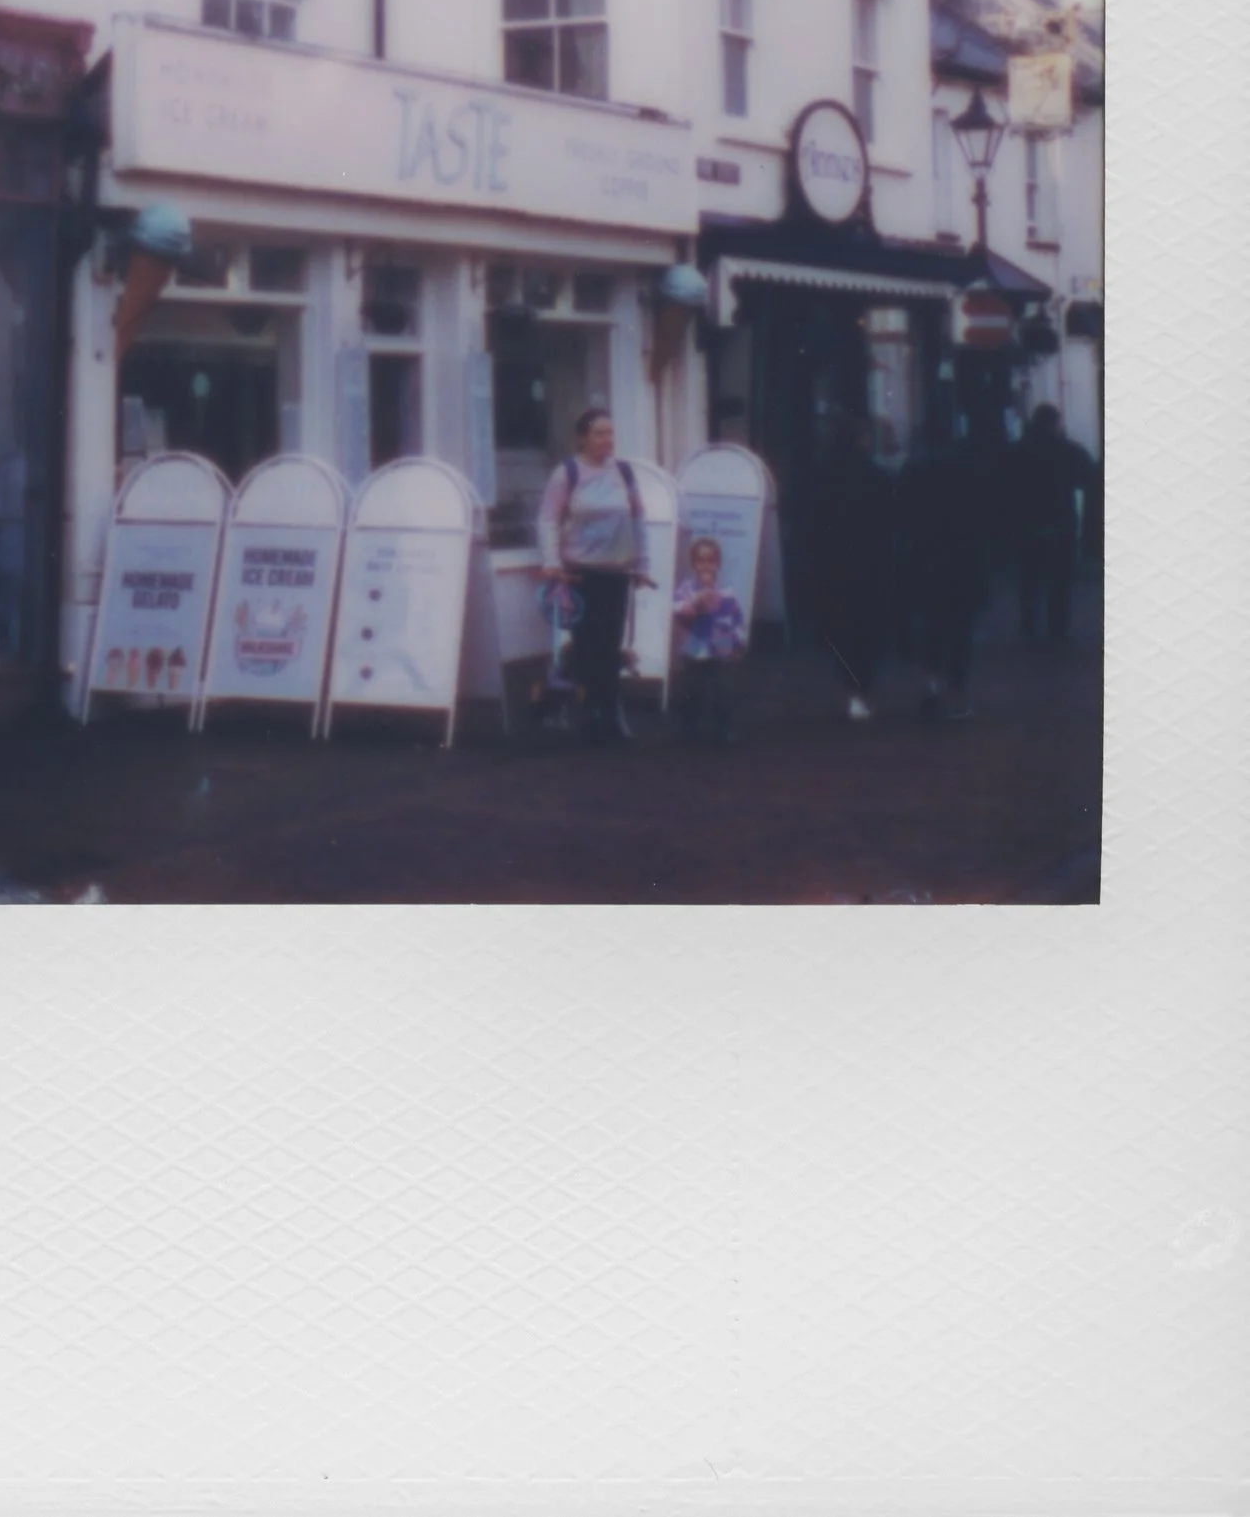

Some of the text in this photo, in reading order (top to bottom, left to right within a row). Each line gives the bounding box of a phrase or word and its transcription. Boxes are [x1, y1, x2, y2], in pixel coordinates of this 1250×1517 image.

[161, 97, 270, 134] ICE CREAM
[391, 86, 513, 193] TASTE
[244, 546, 318, 568] HOMEMADE
[121, 570, 195, 591] HOMEMADE
[241, 568, 316, 588] ICE CREAM
[131, 590, 181, 611] GELATO
